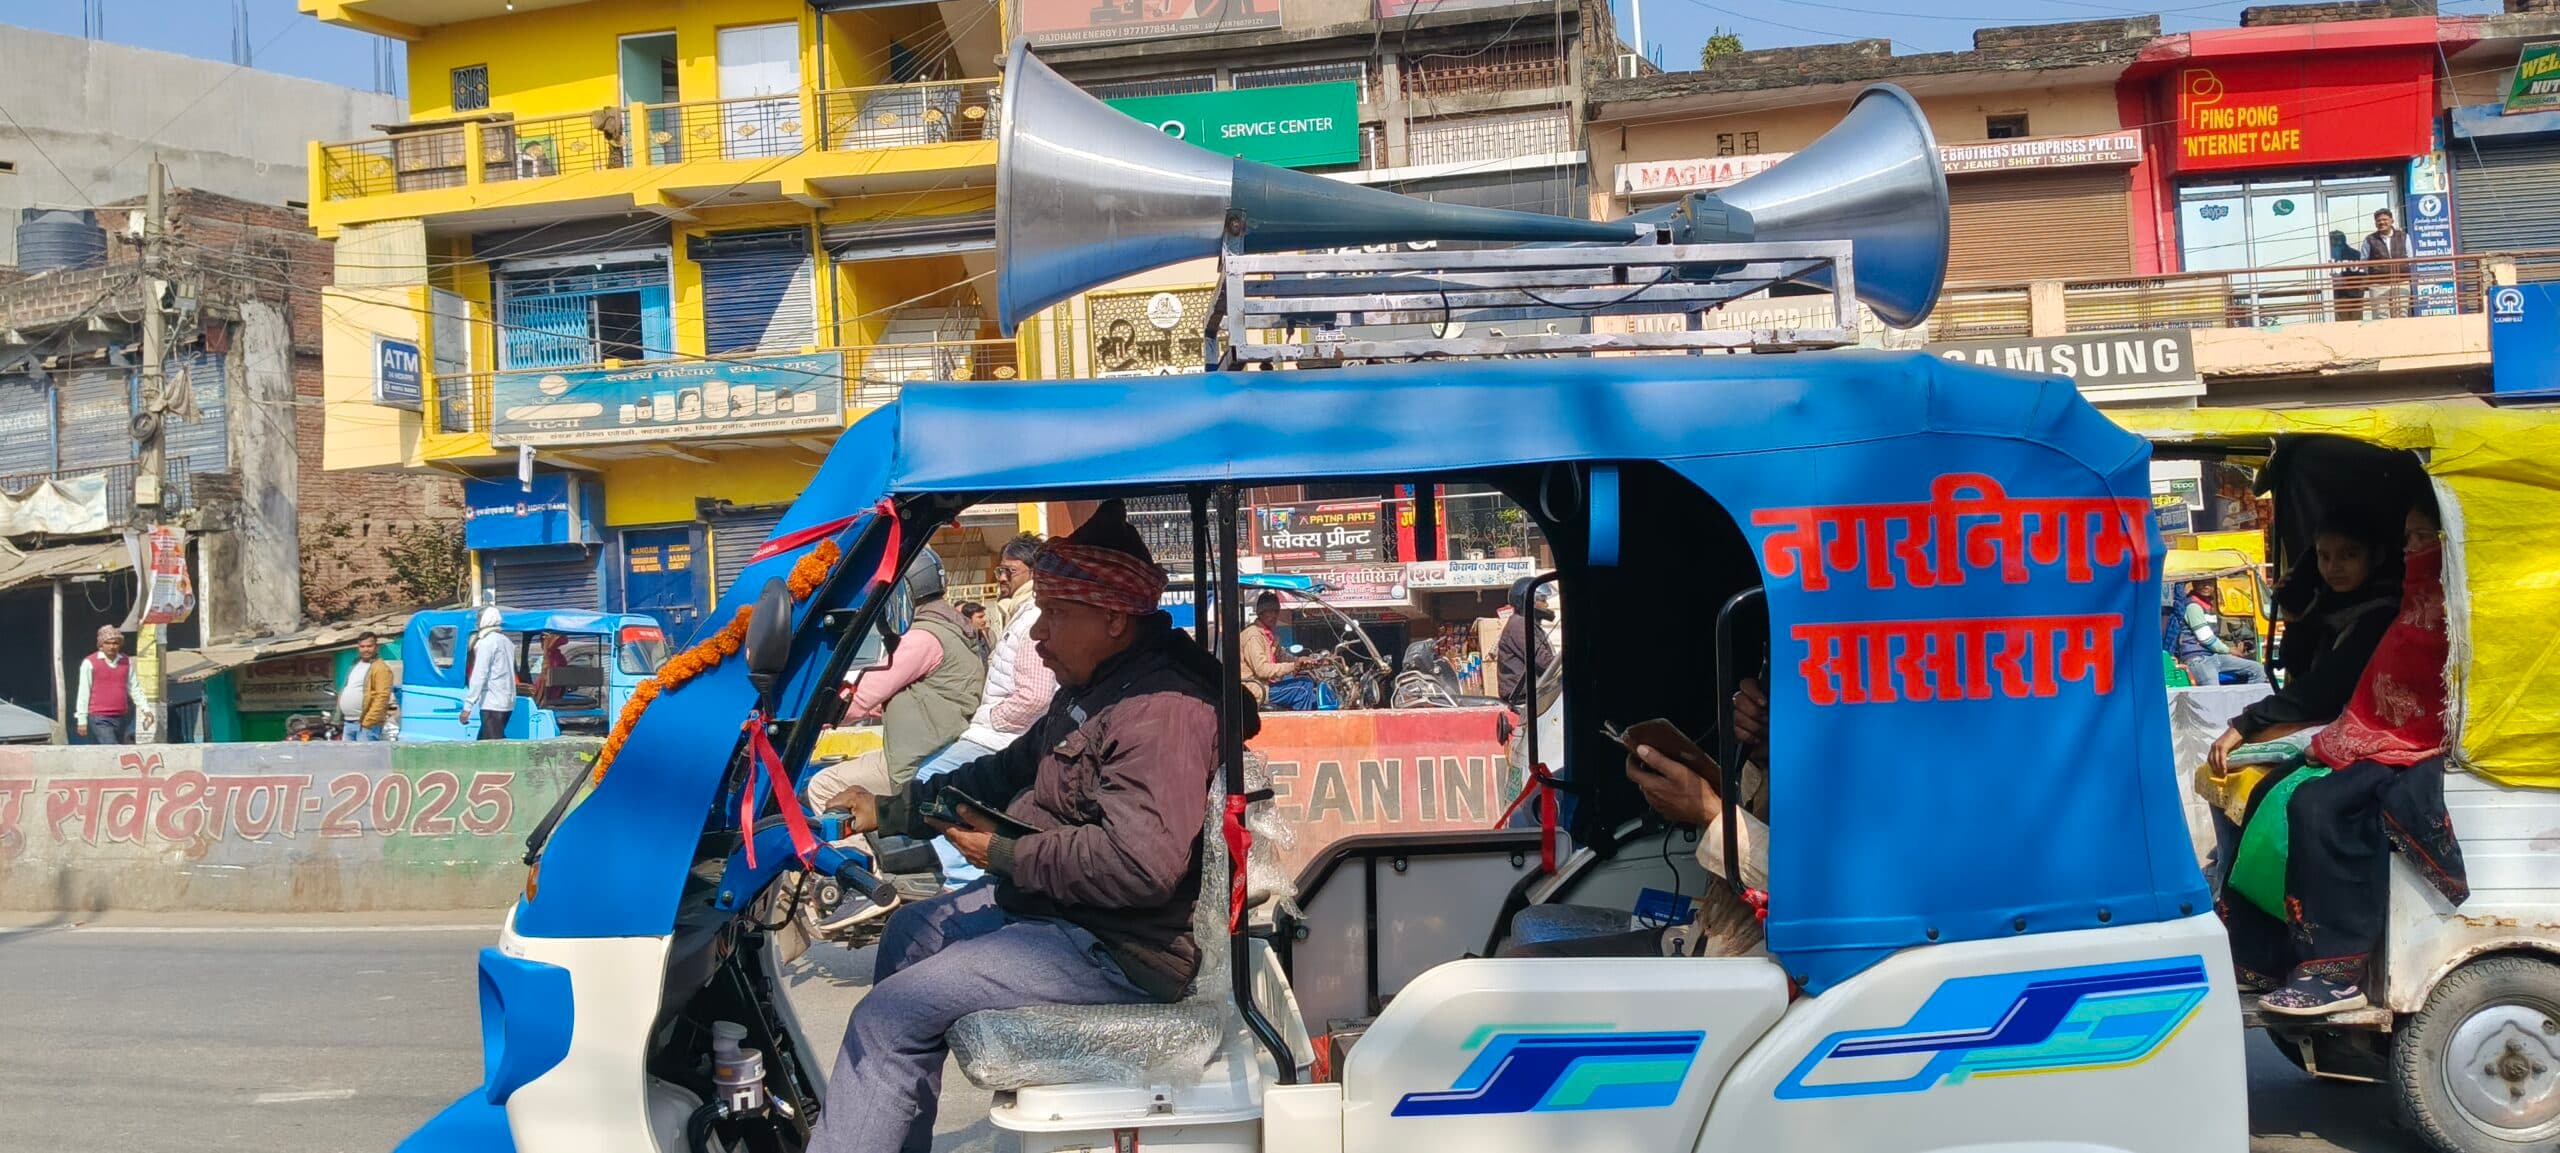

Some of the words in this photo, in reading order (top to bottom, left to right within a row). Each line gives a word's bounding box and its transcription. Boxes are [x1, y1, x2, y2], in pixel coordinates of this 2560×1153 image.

[1039, 32, 1082, 42] RAJDHANI
[1082, 29, 1118, 39] ENERGY
[1220, 120, 1276, 139] SERVICE
[1278, 117, 1333, 135] CENTER
[2200, 108, 2234, 130] PING
[2237, 105, 2278, 128] PONG
[1950, 144, 2009, 162] BROTHERS
[2011, 139, 2087, 157] ENTERPRISES
[2089, 137, 2113, 152] PVT.
[2115, 136, 2137, 150] LTD.
[2261, 129, 2300, 152] CAFE
[1963, 160, 1999, 170] JEANS
[2008, 156, 2041, 166] SHIRT
[2050, 152, 2093, 163] T-SHIRT
[2096, 151, 2121, 161] ETC.
[1641, 163, 1734, 188] MAGMA
[2200, 204, 2229, 221] skype
[383, 348, 419, 373] ATM
[1942, 338, 2180, 378] AMSUNG
[1309, 513, 1345, 525] PATNA
[1347, 511, 1377, 522] ARTS
[1751, 472, 2151, 592] नगरनिगम
[1790, 613, 2124, 706] सासाराम
[1267, 760, 1404, 823] EAN
[1415, 754, 1510, 823] IN
